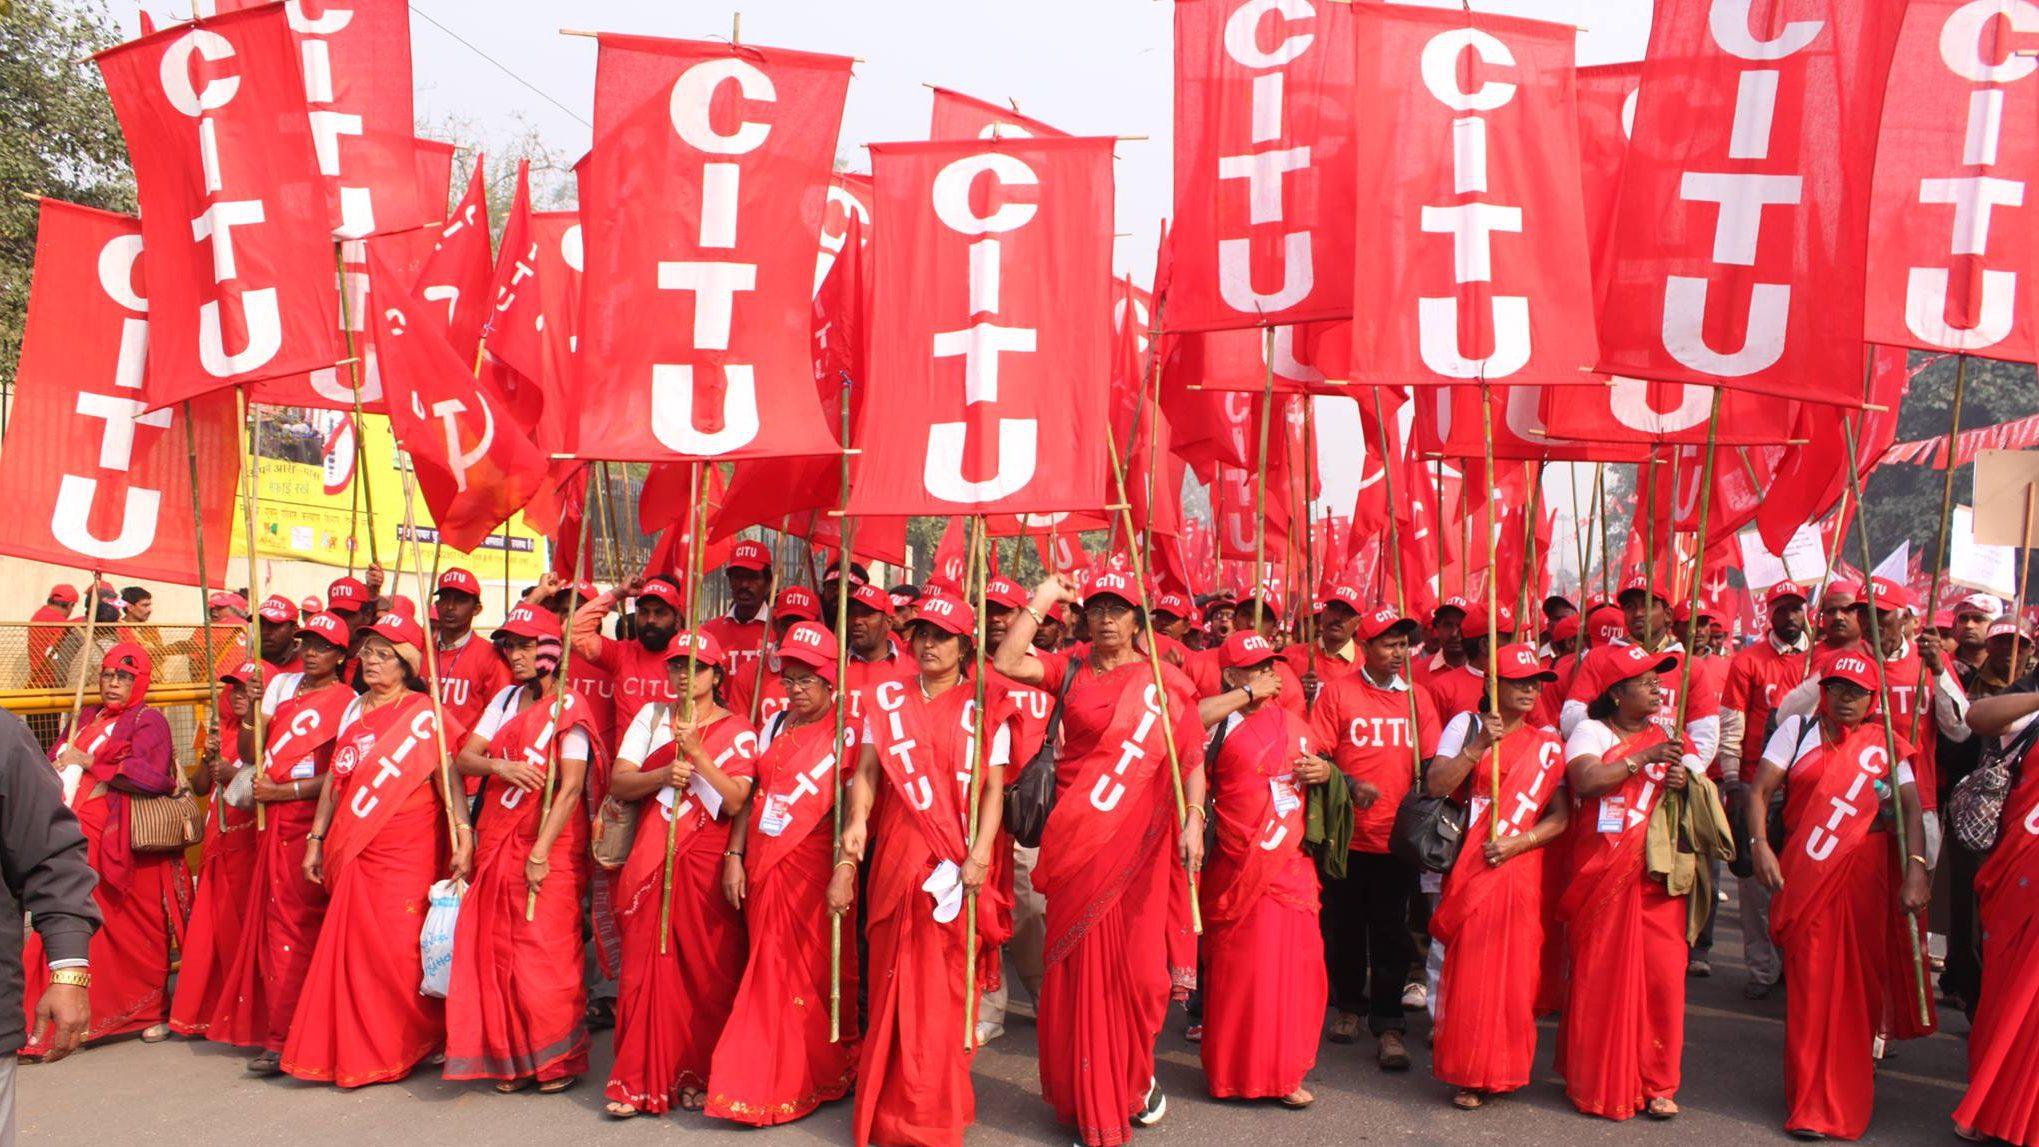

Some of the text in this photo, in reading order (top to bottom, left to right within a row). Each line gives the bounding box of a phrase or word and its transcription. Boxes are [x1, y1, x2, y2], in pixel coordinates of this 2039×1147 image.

[1219, 0, 1317, 314] CITU
[1905, 0, 2039, 350] CITU
[1662, 0, 1825, 377] CITU
[160, 28, 283, 378] CITU
[1418, 27, 1532, 379] CITU
[651, 57, 777, 456] CITU
[924, 152, 1039, 503] CITU
[51, 233, 172, 560] CITU
[736, 546, 757, 558] CITU
[444, 571, 466, 584] CITU
[1096, 573, 1126, 589] CITU
[1776, 581, 1799, 593] CITU
[331, 585, 353, 598] CITU
[643, 584, 668, 594] CITU
[986, 581, 1010, 595] CITU
[1249, 587, 1272, 601] CTU
[1336, 586, 1358, 601] CITU
[1862, 582, 1887, 596] CTU
[786, 593, 809, 607] CITU
[923, 597, 954, 616] CITU
[1161, 595, 1181, 607] CITU
[309, 615, 337, 631] CITU
[509, 608, 534, 622] CITU
[792, 627, 822, 647] CITU
[1601, 624, 1624, 638] CITU
[678, 633, 708, 650] CIU
[1835, 657, 1866, 673] CITU
[440, 676, 470, 706] TU
[566, 677, 614, 699] ITU
[622, 676, 679, 699] CITU
[1008, 690, 1048, 720] TU
[262, 708, 321, 772] CIT
[877, 680, 934, 812] CITU
[1089, 683, 1168, 812] CITU
[351, 709, 437, 819] CITU
[1805, 744, 1889, 861] CITU
